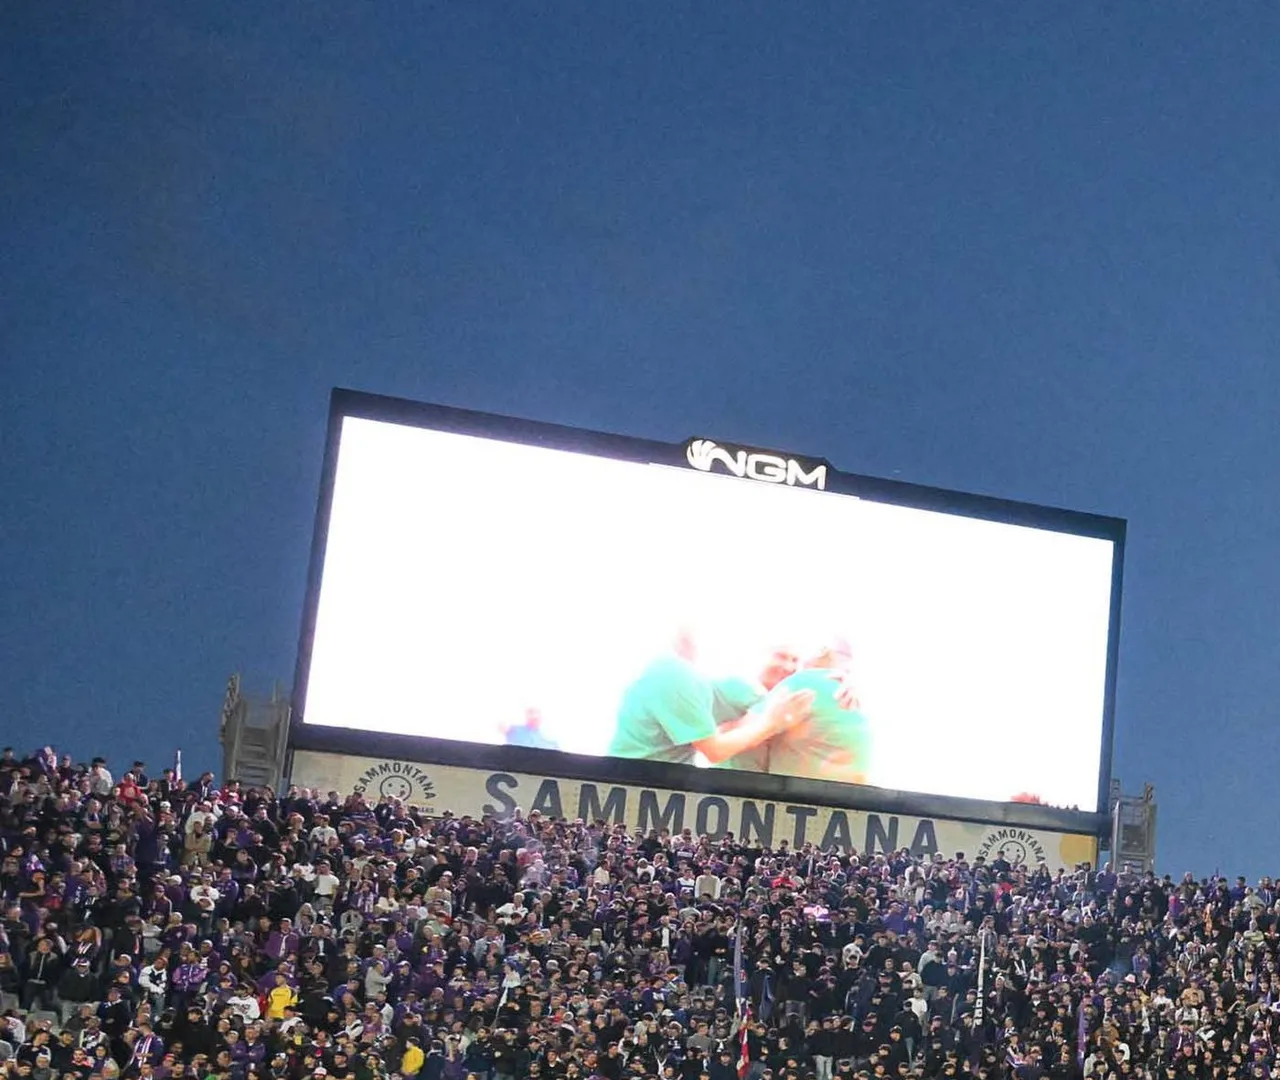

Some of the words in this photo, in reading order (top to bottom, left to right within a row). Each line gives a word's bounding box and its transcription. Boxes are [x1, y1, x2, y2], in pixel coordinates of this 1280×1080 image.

[692, 439, 827, 490] NGM
[353, 762, 437, 800] SAMMONTANA
[484, 772, 941, 858] SAMMONTANA
[979, 828, 1046, 863] SAMMONTANA
